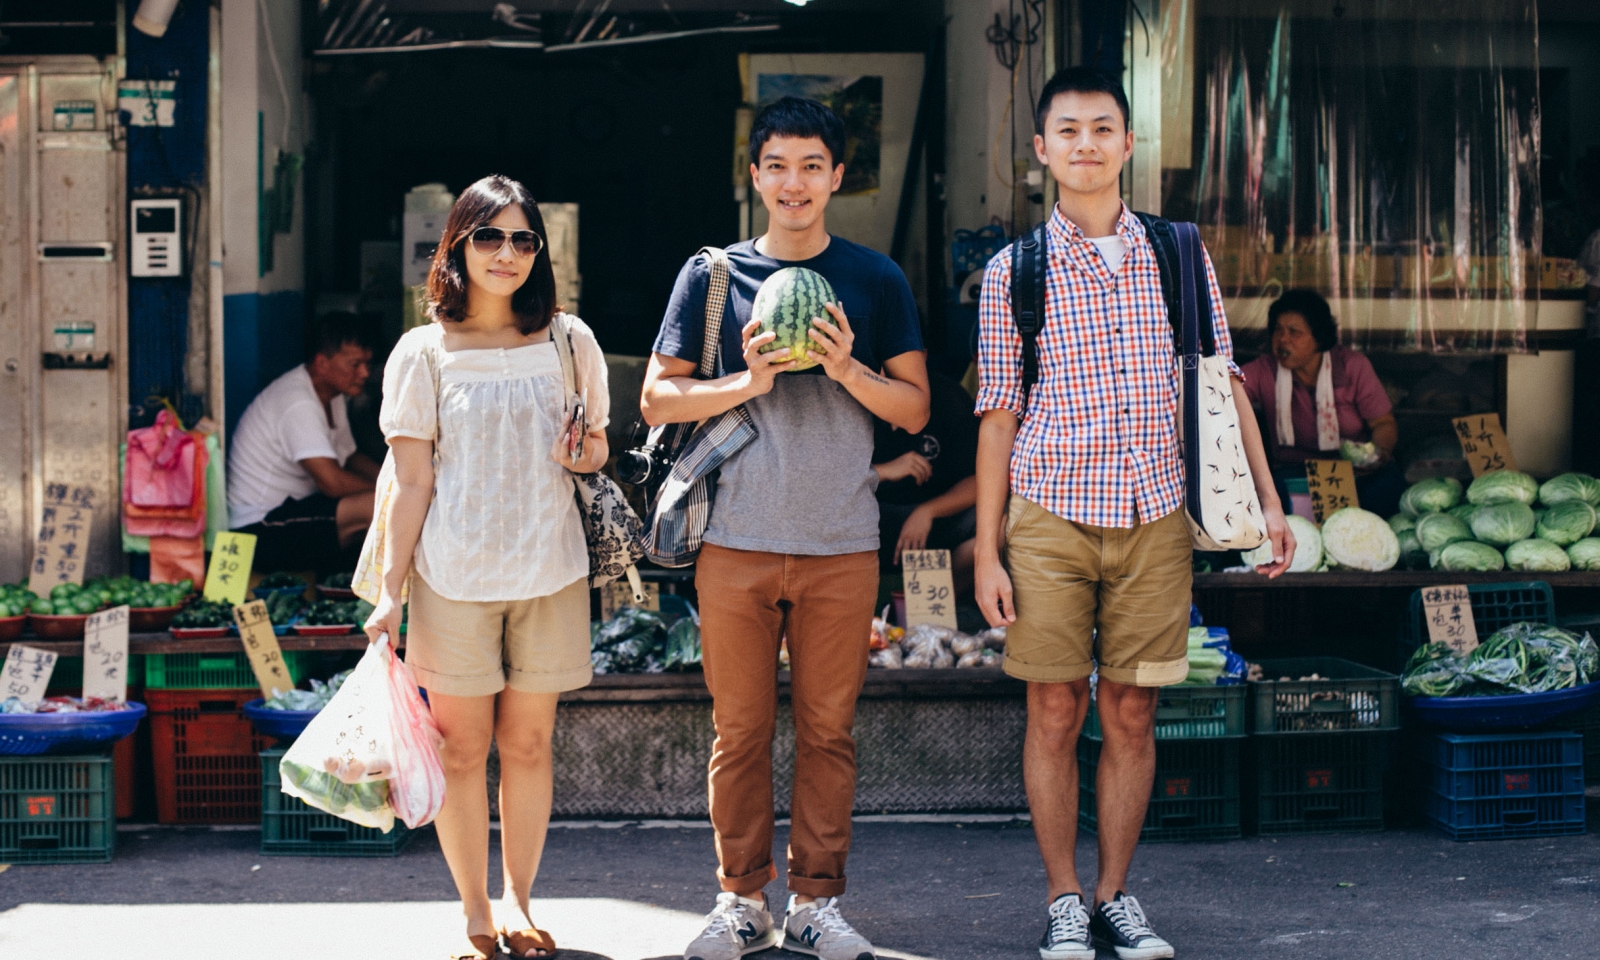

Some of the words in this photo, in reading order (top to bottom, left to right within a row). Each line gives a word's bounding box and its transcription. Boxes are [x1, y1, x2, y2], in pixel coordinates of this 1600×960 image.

[142, 102, 157, 122] 3
[1480, 452, 1506, 471] 25
[1327, 494, 1350, 509] 35
[217, 559, 239, 573] 30
[926, 585, 949, 601] 30
[1446, 625, 1466, 637] 30
[8, 682, 30, 696] 50
[737, 920, 758, 946] N
[800, 924, 822, 948] N
